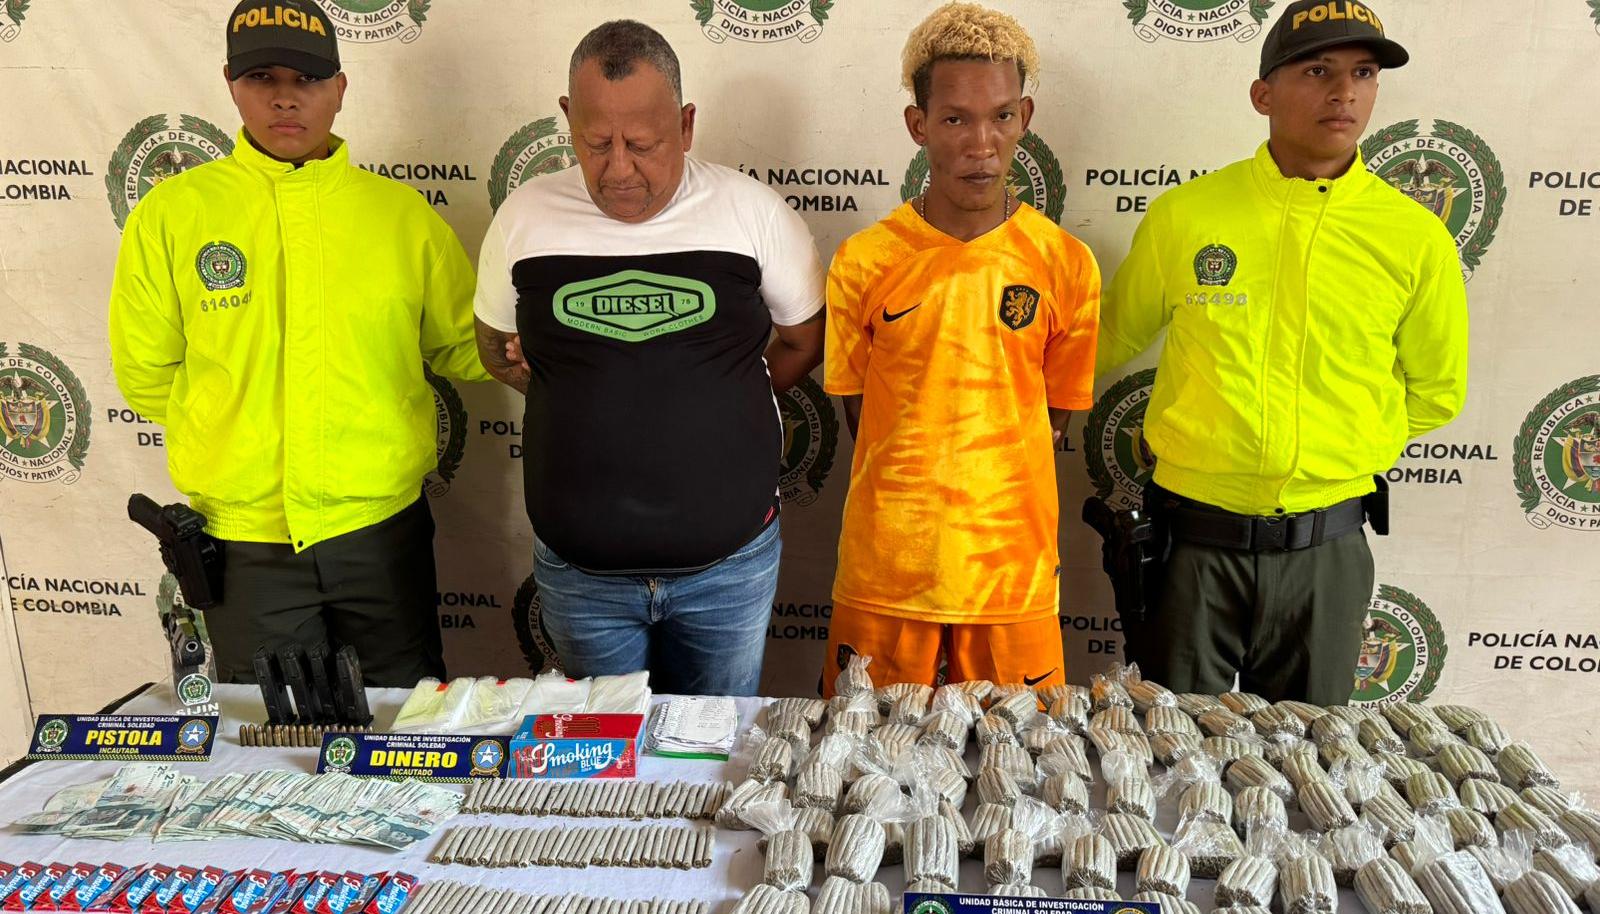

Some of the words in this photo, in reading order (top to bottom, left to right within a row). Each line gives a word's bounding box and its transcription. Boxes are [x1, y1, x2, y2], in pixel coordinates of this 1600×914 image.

[232, 6, 327, 36] POLICIA
[365, 21, 405, 39] PATRIA
[721, 19, 749, 37] DIOS
[751, 29, 759, 39] Y
[762, 19, 805, 39] PATRIA
[1154, 18, 1183, 37] DIOS
[1185, 29, 1194, 38] Y
[1197, 18, 1242, 38] PATRIA
[168, 132, 186, 141] DE
[767, 168, 890, 186] NACIONAL
[1016, 148, 1044, 211] OLOMBIA
[1086, 164, 1182, 186] POLICÍA
[1416, 138, 1436, 149] DE
[1448, 146, 1484, 214] COLOMBIA
[784, 195, 858, 212] OMBIA
[1116, 196, 1147, 212] DE
[1559, 199, 1593, 217] DE
[595, 294, 680, 317] DIESEL
[567, 317, 601, 331] MODERN
[604, 328, 628, 338] BASIC
[643, 326, 666, 337] WORK
[8, 358, 24, 367] DE
[35, 365, 76, 423] COLOMBIA
[790, 388, 820, 443] OLOMBIA
[137, 432, 164, 447] DE
[29, 435, 73, 467] NACIONAL
[1401, 442, 1498, 460] CIONAL
[31, 465, 65, 480] PATRIA
[1386, 467, 1463, 484] OMBIA
[1120, 496, 1141, 511] DIO
[1546, 507, 1577, 525] DIOS
[45, 577, 146, 596] NACIONAL
[23, 598, 122, 616] COLOMBIA
[1060, 615, 1124, 632] POLIC
[1392, 607, 1426, 667] COLOMBIA
[1468, 629, 1558, 648] POLICÍA
[1087, 639, 1116, 654] DE
[1494, 655, 1524, 670] DE
[1529, 656, 1600, 673] COLO
[85, 730, 163, 746] PISTOLA
[389, 734, 411, 742] BÁSICA
[422, 735, 471, 743] INVESTIGACIÓN
[370, 750, 458, 768] DINERO
[531, 742, 613, 774] Smoking
[581, 756, 603, 769] BLUE
[390, 768, 433, 776] INCAUTADO
[959, 897, 991, 906] UNIDAD
[993, 897, 1024, 908] BÁSICA
[1026, 899, 1037, 908] DE
[1039, 900, 1104, 911] INVESTIGACIÓN
